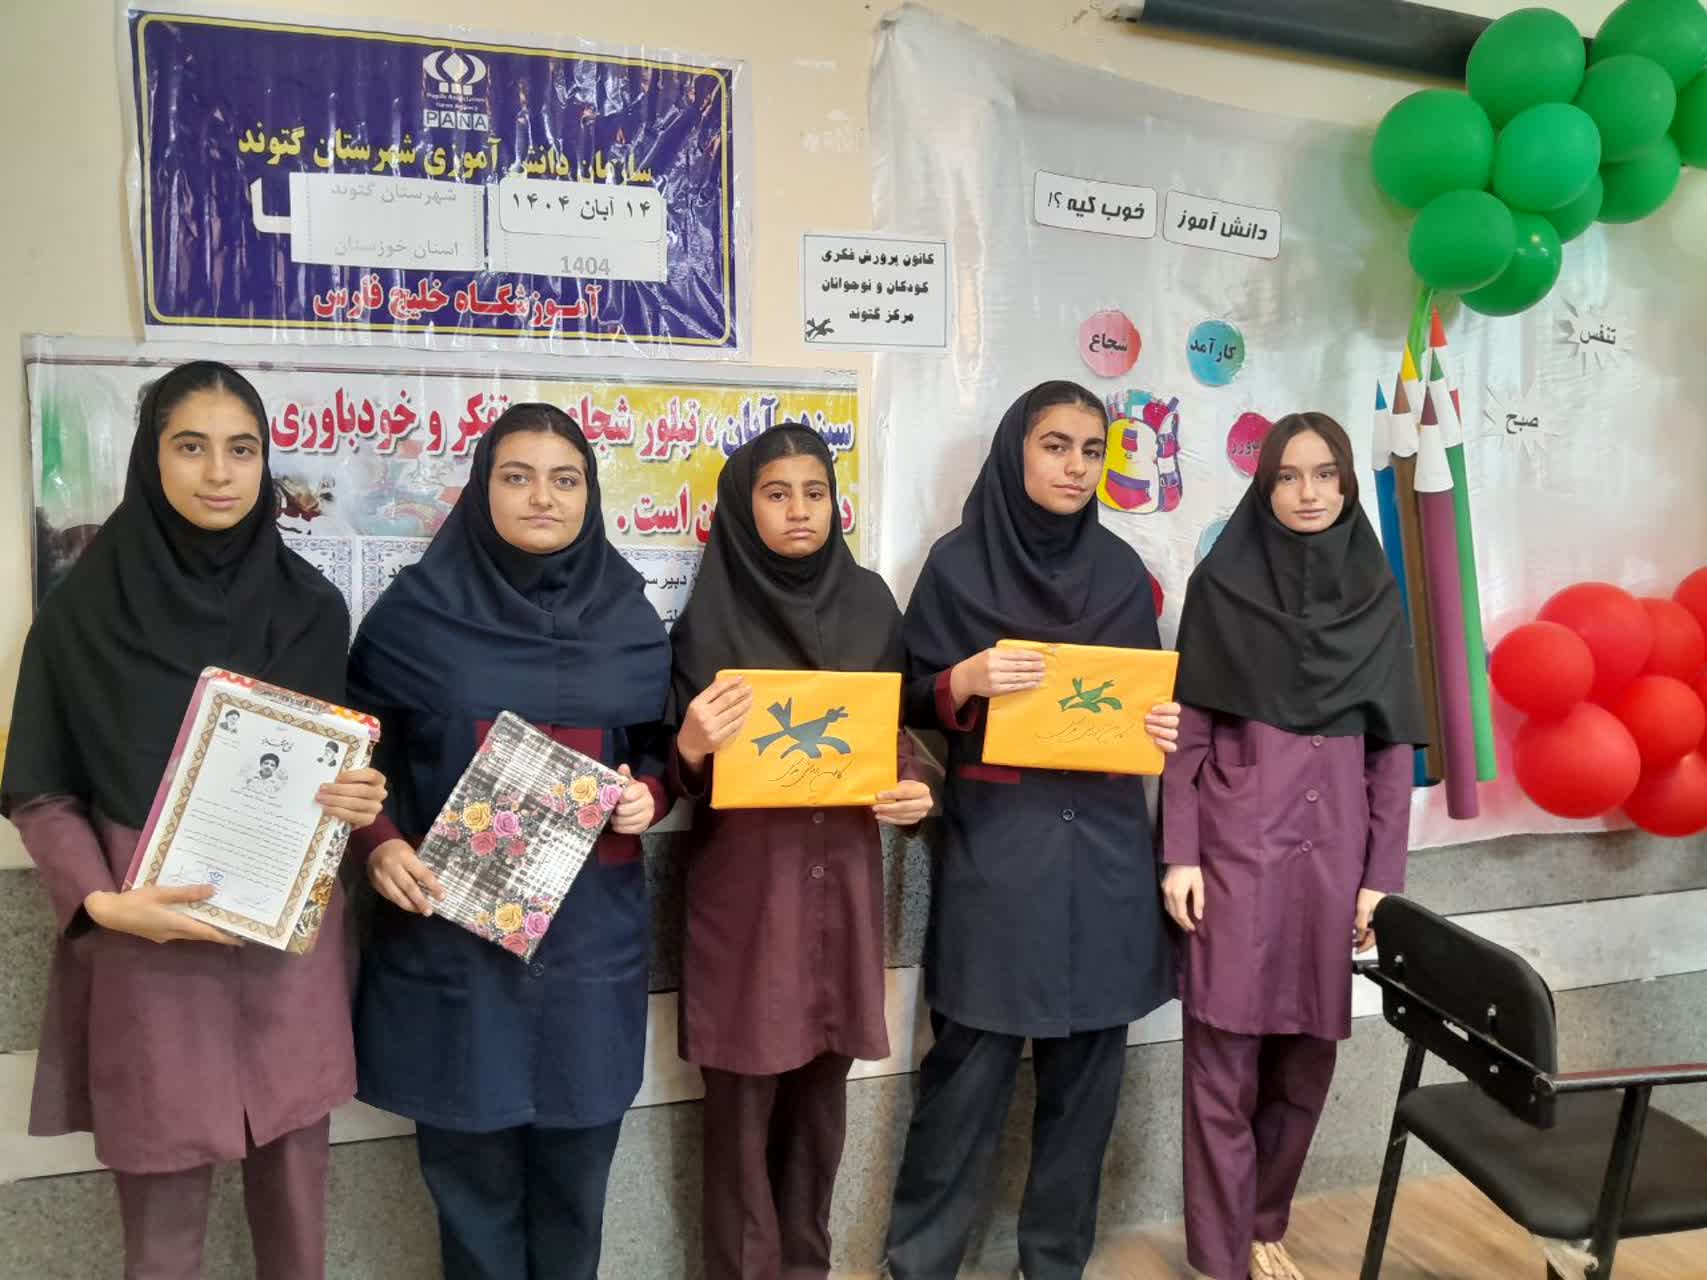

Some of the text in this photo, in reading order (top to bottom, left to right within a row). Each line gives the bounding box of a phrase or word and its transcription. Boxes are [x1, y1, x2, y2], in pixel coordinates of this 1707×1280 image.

[425, 111, 487, 129] PANA
[238, 122, 305, 165] گتوند
[313, 128, 417, 172] شهرستان
[580, 196, 614, 221] آبان
[1101, 202, 1145, 222] خوب
[1178, 210, 1268, 240] دانش آموز
[560, 256, 611, 275] 1404
[821, 247, 934, 267] کانون پرورش فکری
[822, 276, 928, 296] کودکان و نوجوانان
[313, 274, 602, 326] آموزشگاه خلیج فارس
[885, 308, 914, 324] مرکز
[1580, 323, 1616, 345] تنفس
[271, 387, 417, 450] خودباوری
[426, 410, 442, 450] و
[640, 397, 698, 457] تبلور
[1505, 411, 1539, 434] صبح
